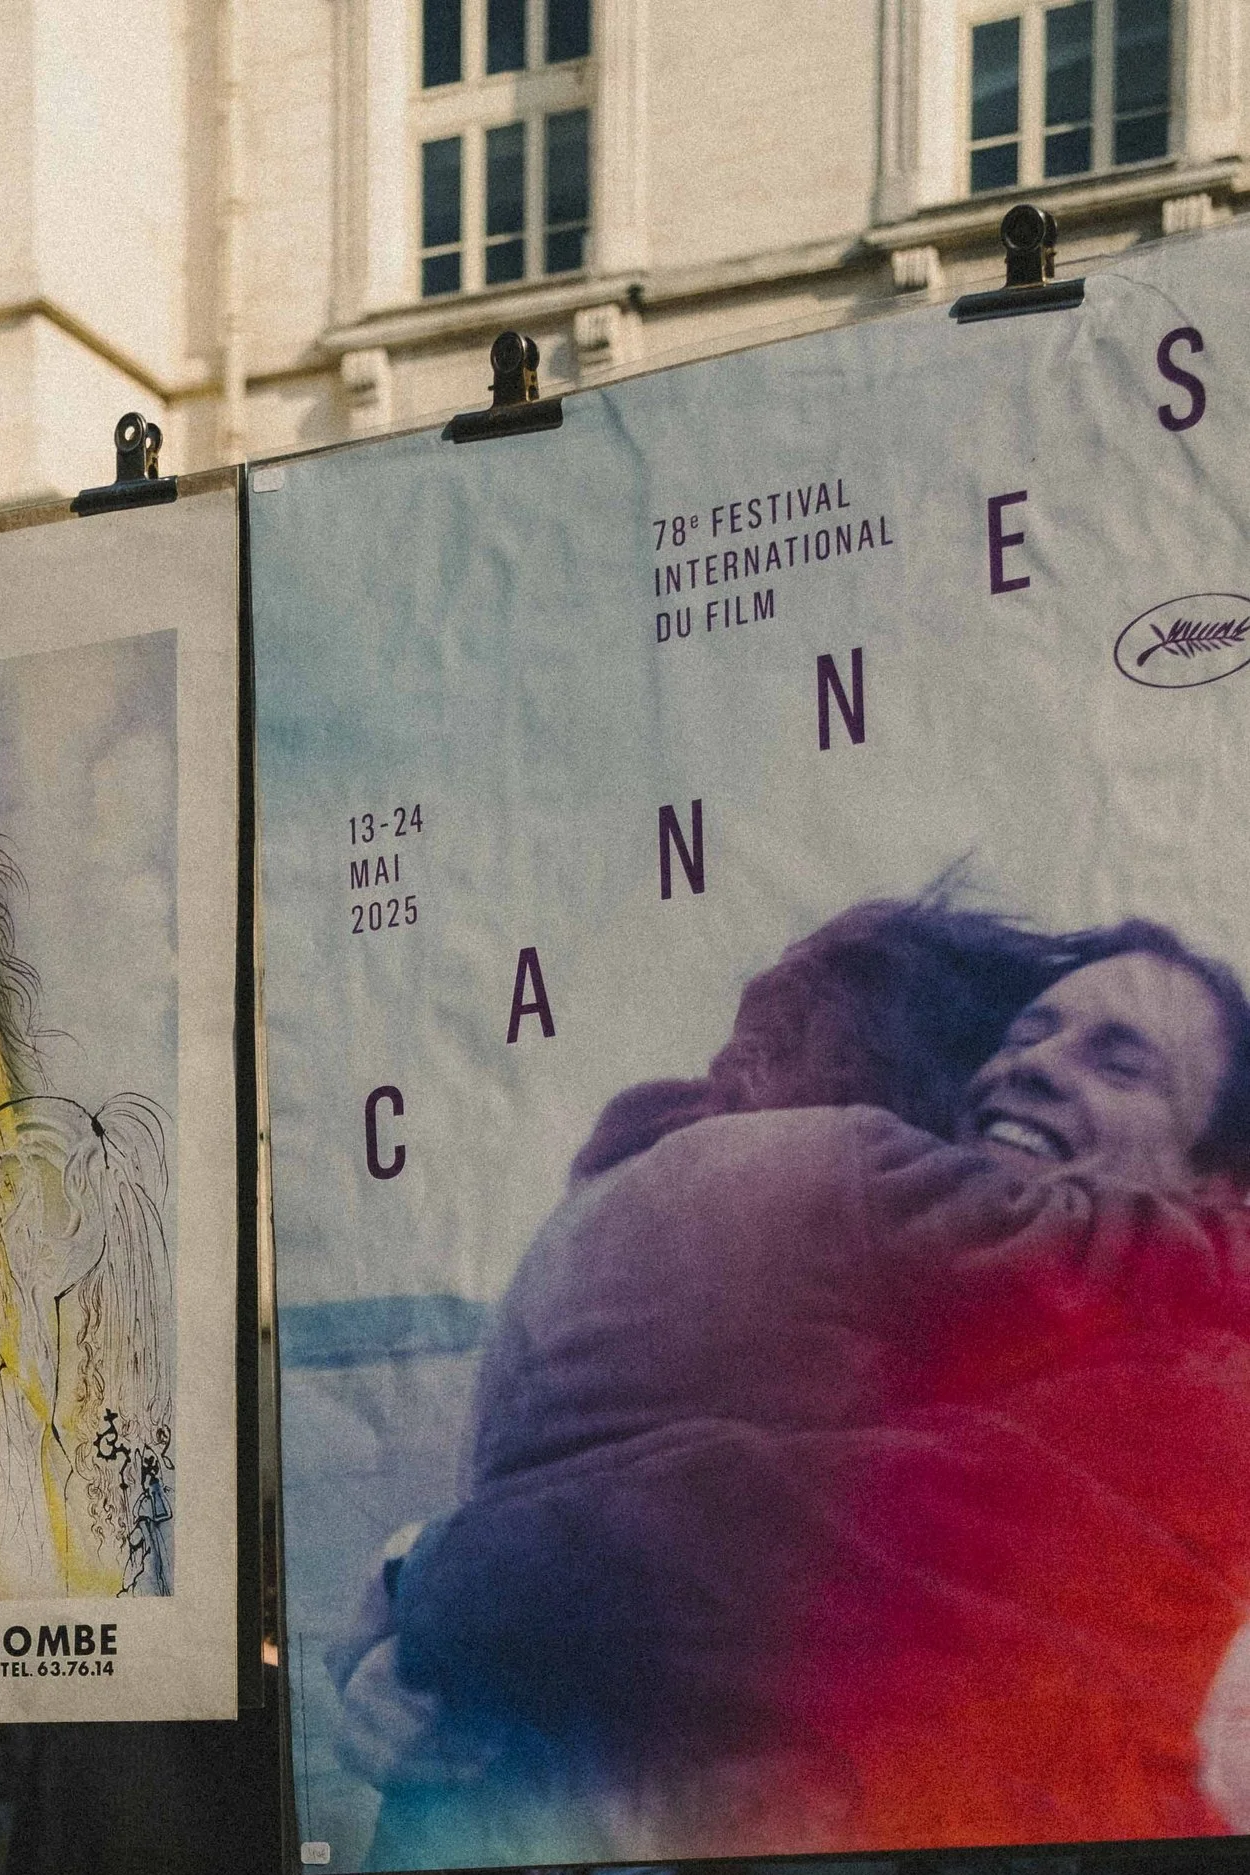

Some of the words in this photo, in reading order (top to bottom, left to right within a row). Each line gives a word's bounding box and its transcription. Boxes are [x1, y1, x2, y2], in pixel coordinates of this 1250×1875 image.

[712, 478, 850, 537] FESTIVAL
[655, 515, 894, 597] INTERNATIONAL
[656, 607, 691, 643] DU
[706, 589, 775, 632] FILM
[349, 803, 424, 845] 13-24
[350, 853, 400, 890] MAI
[351, 895, 418, 934] 2025
[0, 1661, 34, 1678] TEL.
[37, 1660, 115, 1678] 63.76.14
